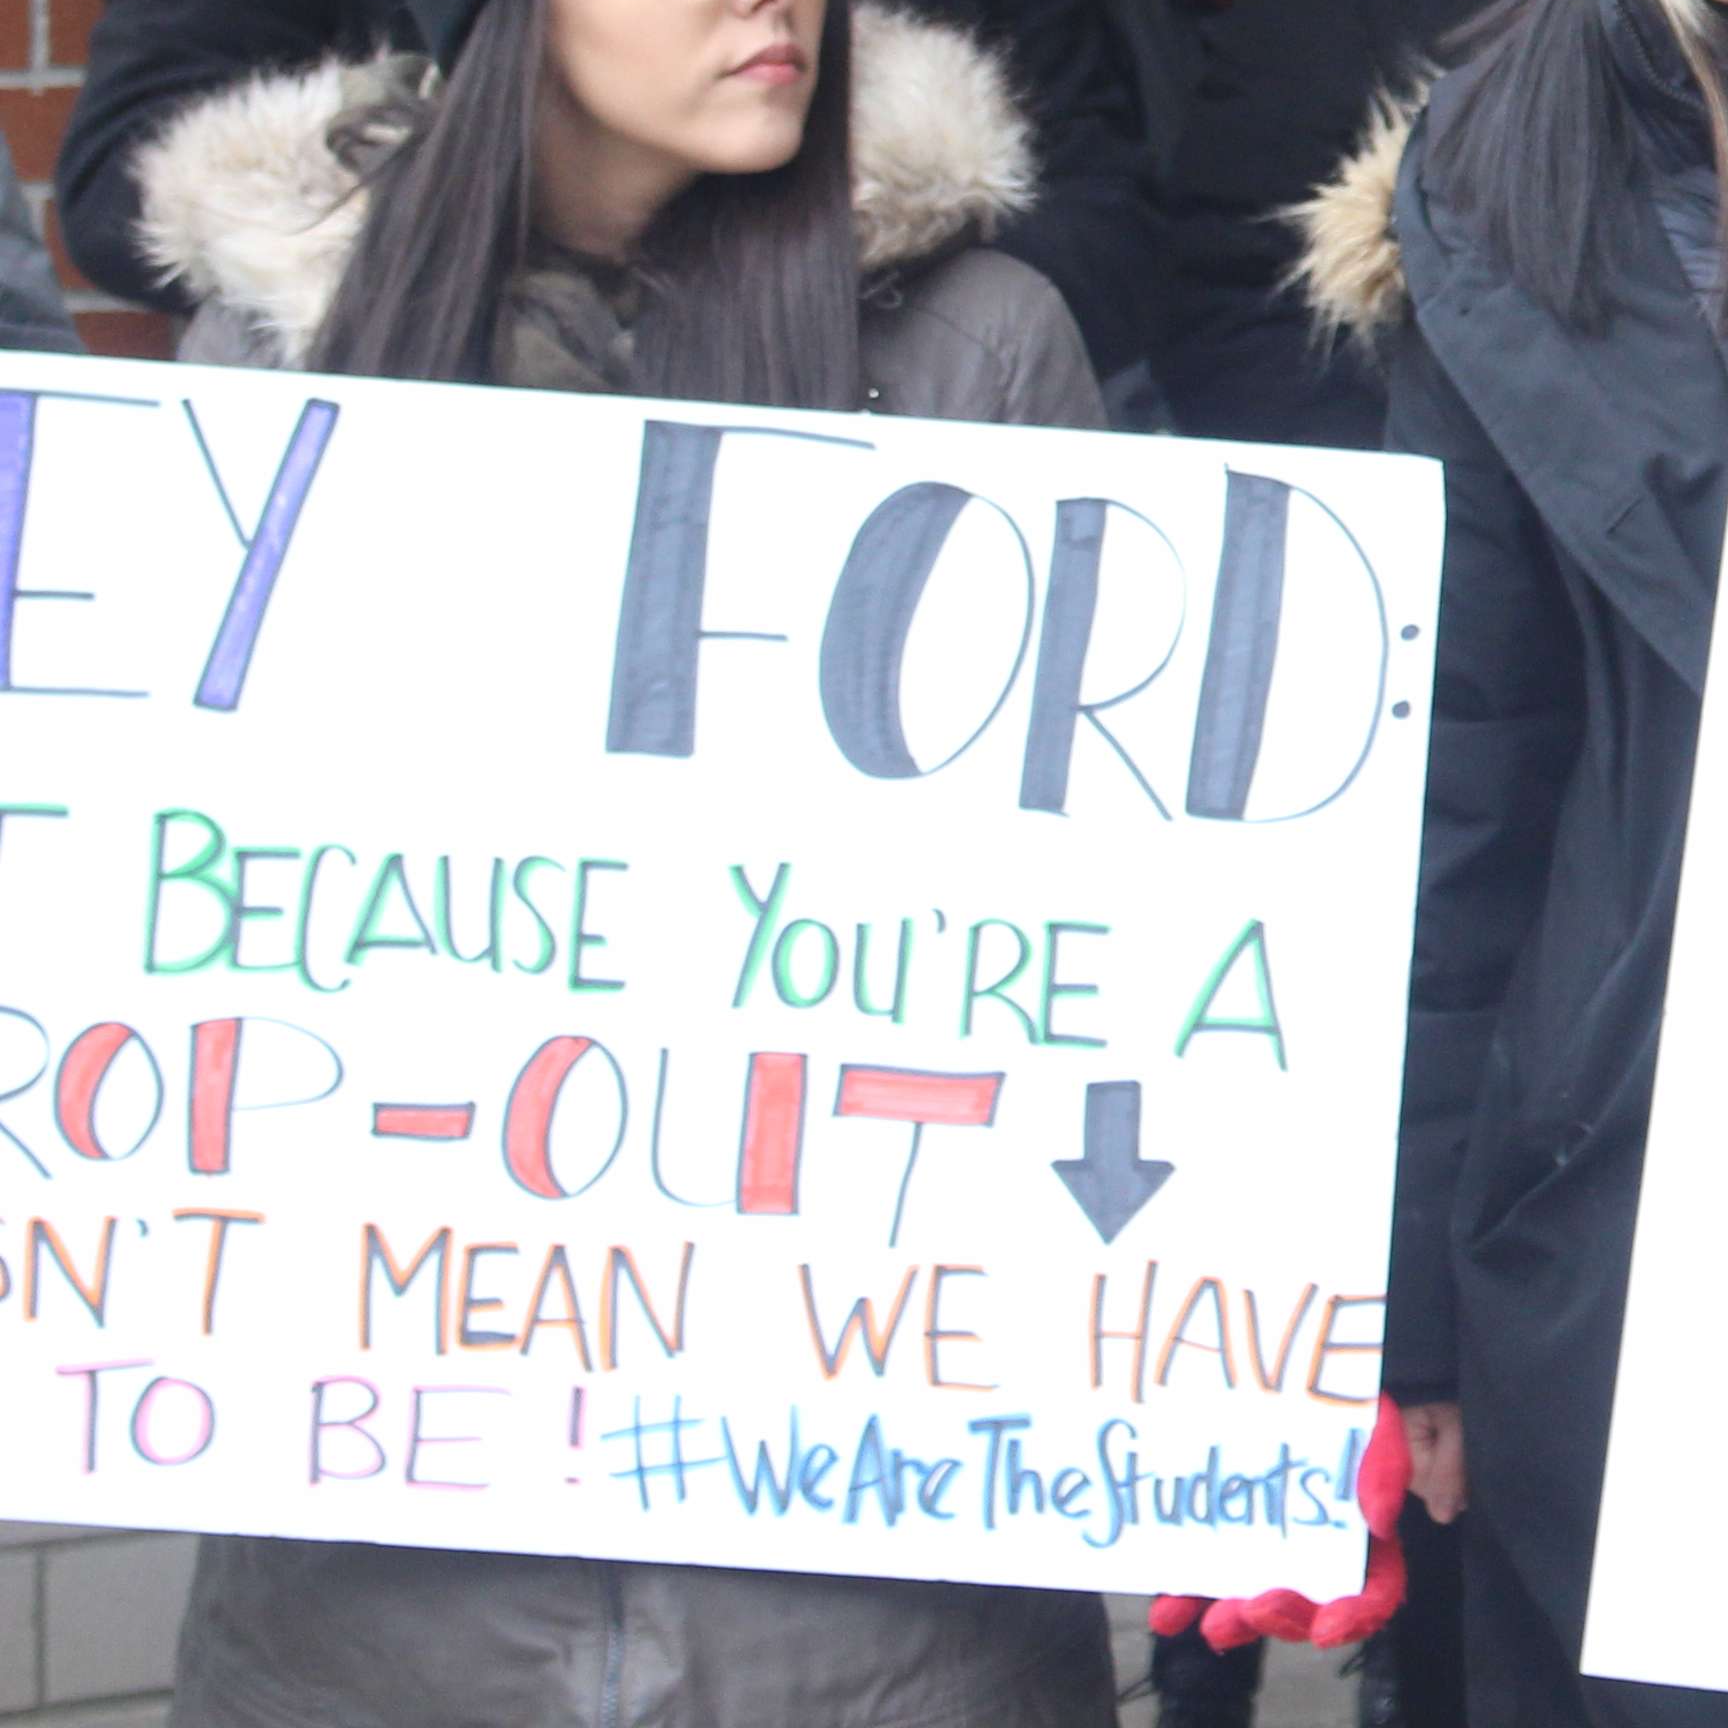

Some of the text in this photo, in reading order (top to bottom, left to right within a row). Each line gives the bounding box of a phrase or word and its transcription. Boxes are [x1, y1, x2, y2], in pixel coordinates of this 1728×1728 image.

[604, 418, 1421, 823] FORD:
[142, 806, 630, 994] BECAUSE
[728, 861, 1112, 1050] YOU'RE
[1173, 918, 1288, 1073] A
[56, 1360, 216, 1474] TO
[358, 1222, 695, 1373] MEAN
[798, 1263, 1000, 1392] WE
[1089, 1259, 1387, 1404] HAVE
